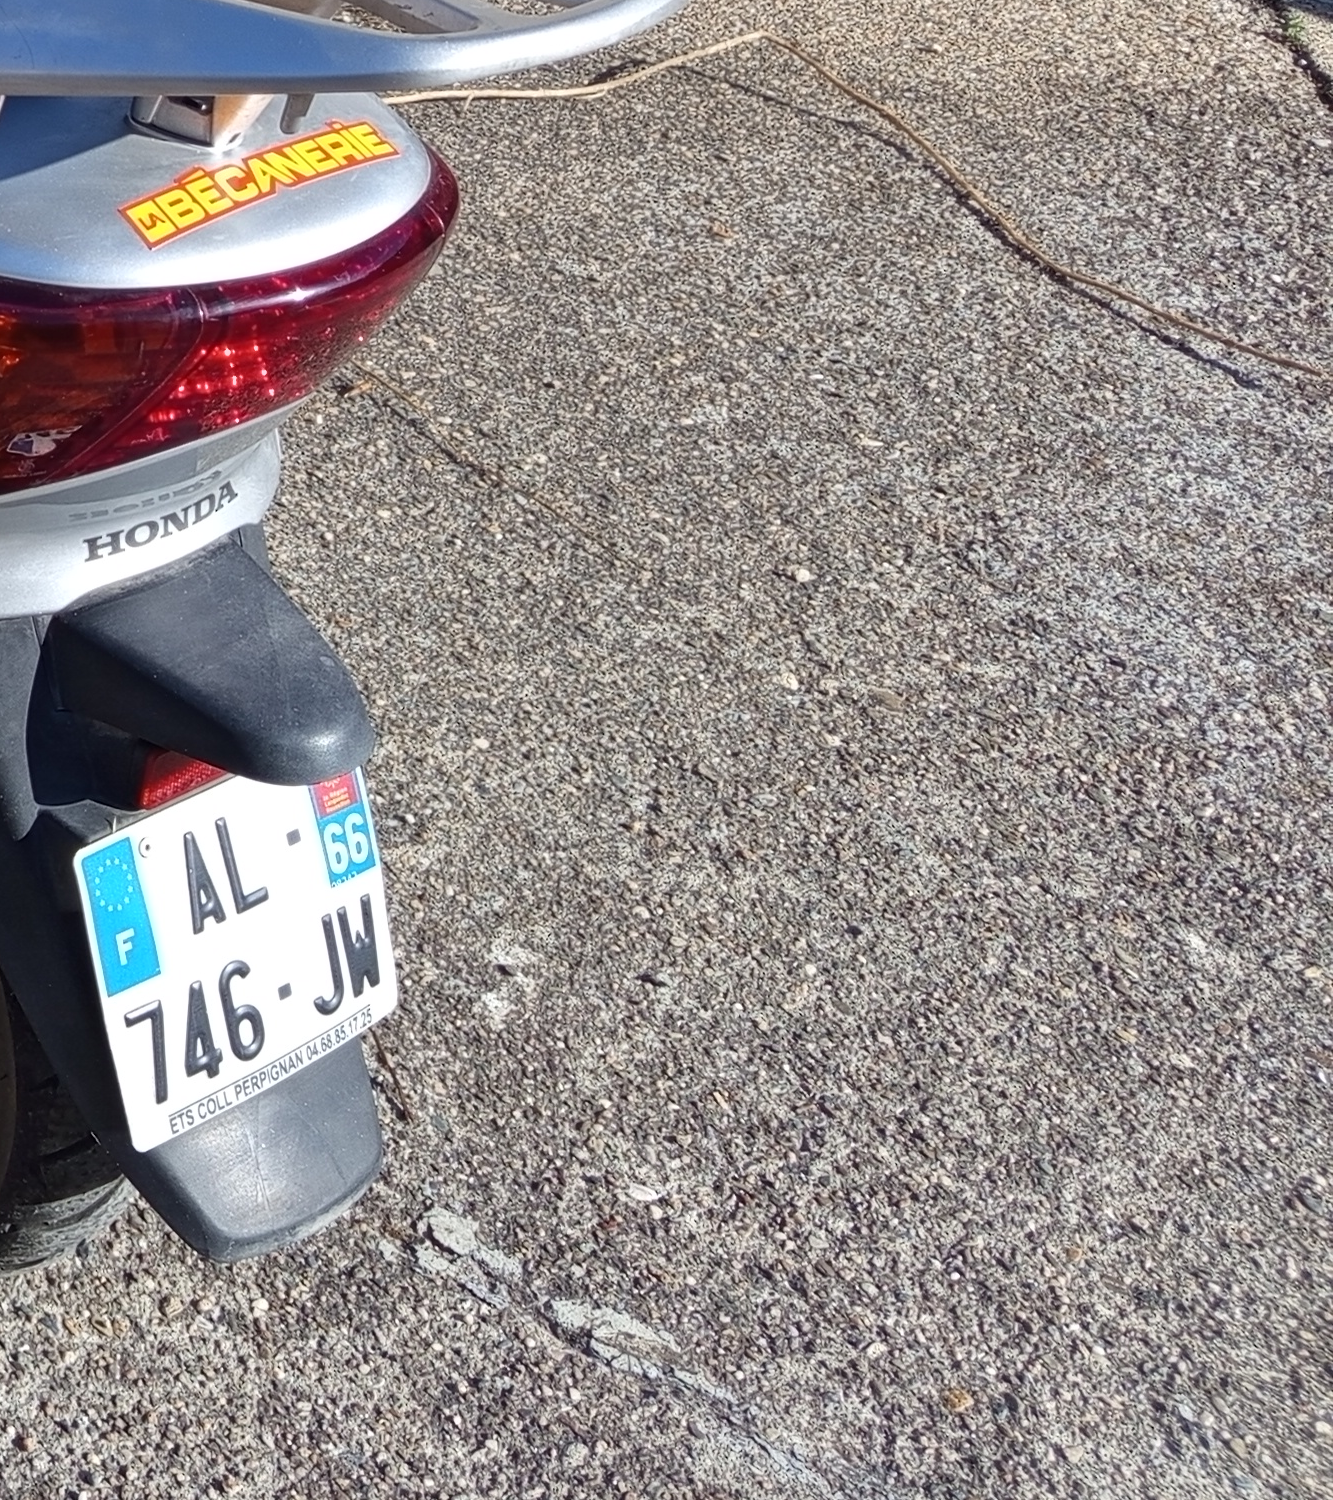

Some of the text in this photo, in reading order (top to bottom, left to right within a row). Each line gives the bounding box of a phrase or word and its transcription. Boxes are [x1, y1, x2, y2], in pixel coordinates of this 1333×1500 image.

[154, 121, 395, 230] BÉCANERIE
[82, 480, 239, 563] HONDA
[322, 811, 370, 875] 66
[115, 927, 136, 966] F
[168, 1007, 373, 1135] ETS COLL PERPIGNAN 04.68.85.17.25
